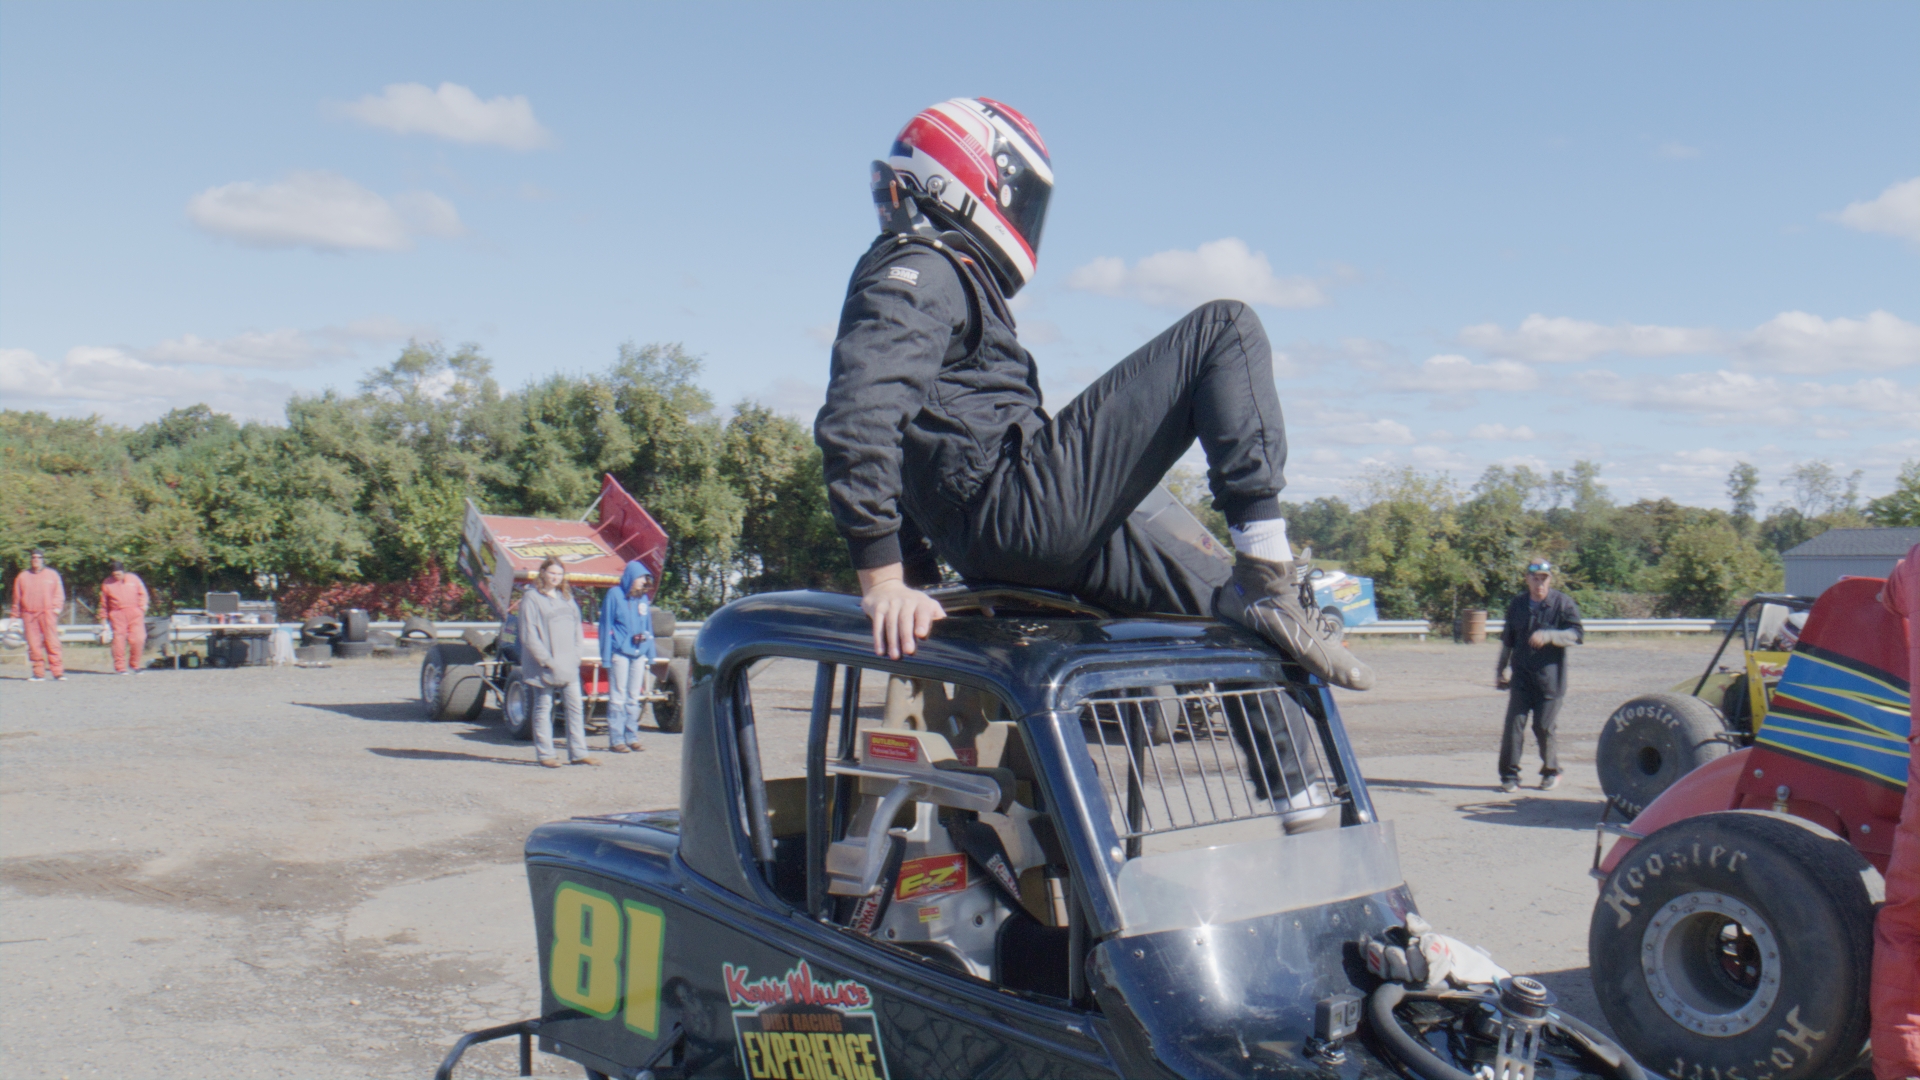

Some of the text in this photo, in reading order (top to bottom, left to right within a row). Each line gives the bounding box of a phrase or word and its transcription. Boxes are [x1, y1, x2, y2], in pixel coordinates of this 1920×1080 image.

[889, 269, 918, 281] OMP
[1612, 704, 1680, 732] Hoosier
[900, 866, 956, 897] E-Z
[1604, 842, 1747, 929] Hoosier
[549, 881, 666, 1040] 81
[761, 1013, 843, 1032] DIRT RACING
[743, 1032, 882, 1080] EXPERIENCE
